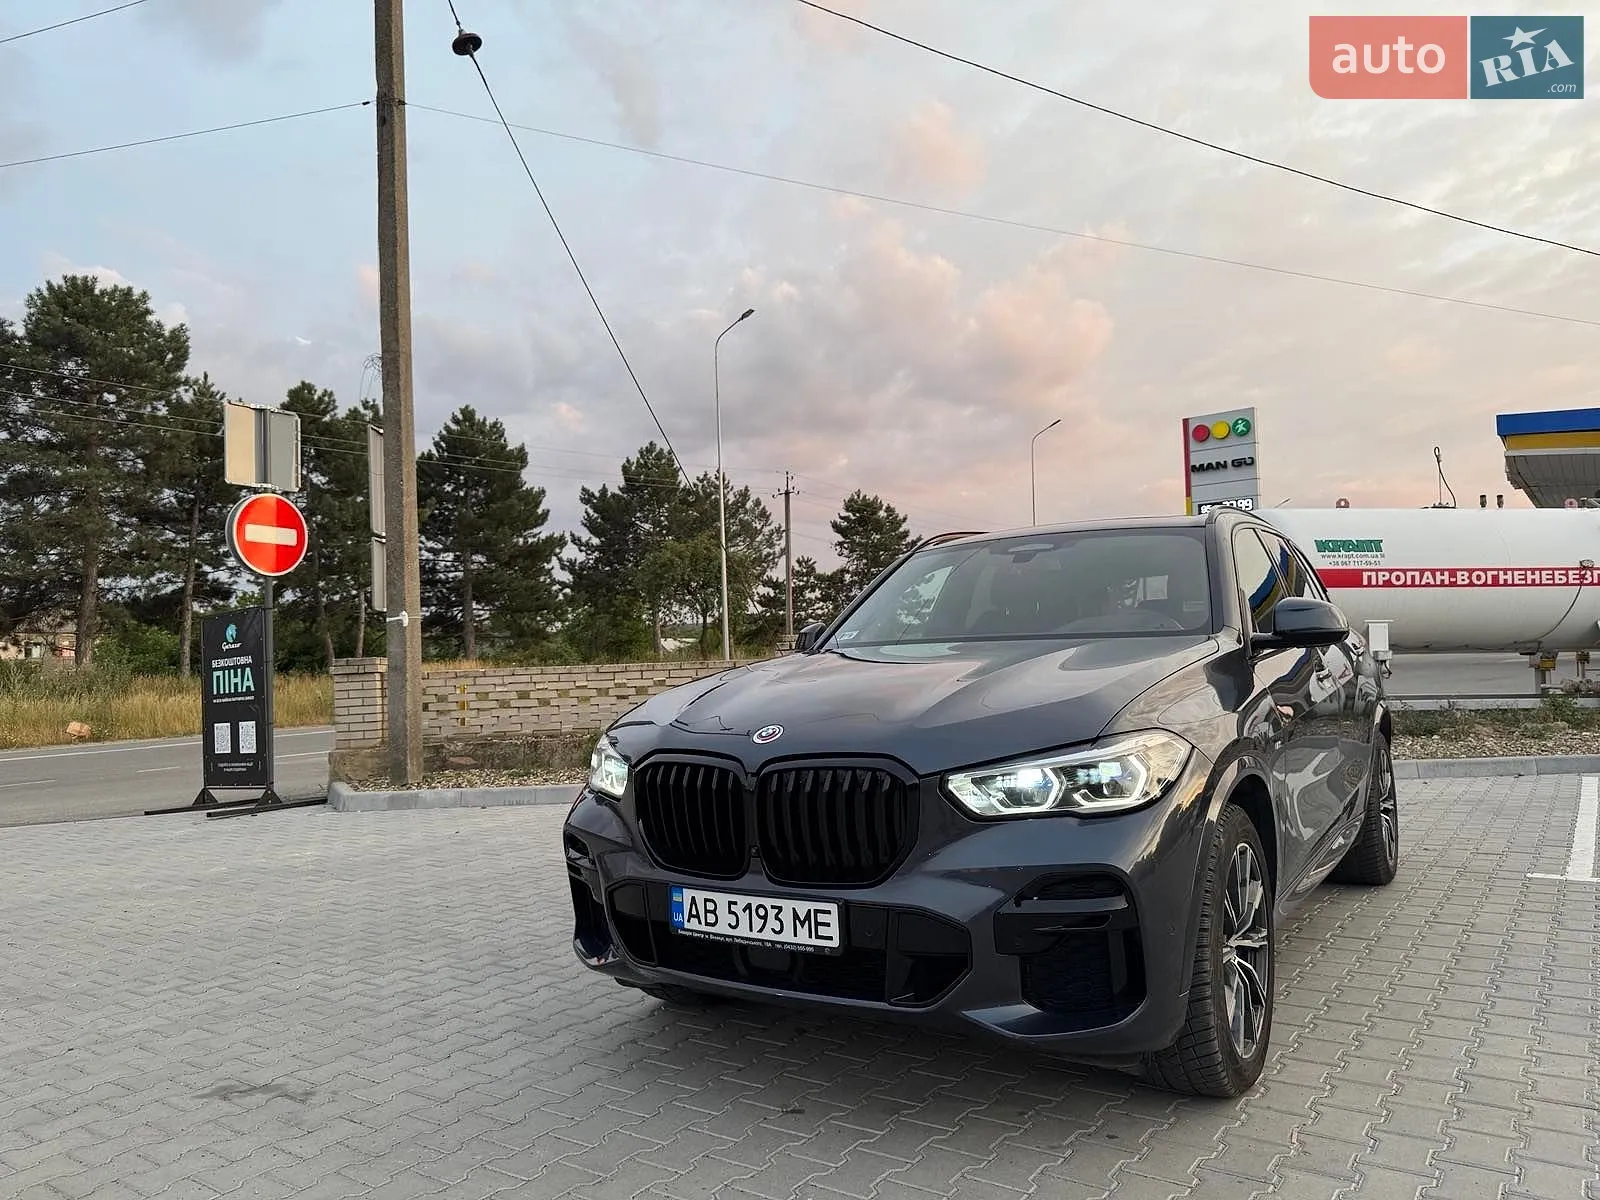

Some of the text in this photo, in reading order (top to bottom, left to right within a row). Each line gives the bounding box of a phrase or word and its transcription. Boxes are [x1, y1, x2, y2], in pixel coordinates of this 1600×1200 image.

[1191, 460, 1227, 473] MAN
[211, 655, 253, 668] БЕЗКОШТОВНА
[212, 667, 255, 695] ПІНА
[673, 912, 683, 922] UA
[687, 895, 834, 941] AB 5193 ME
